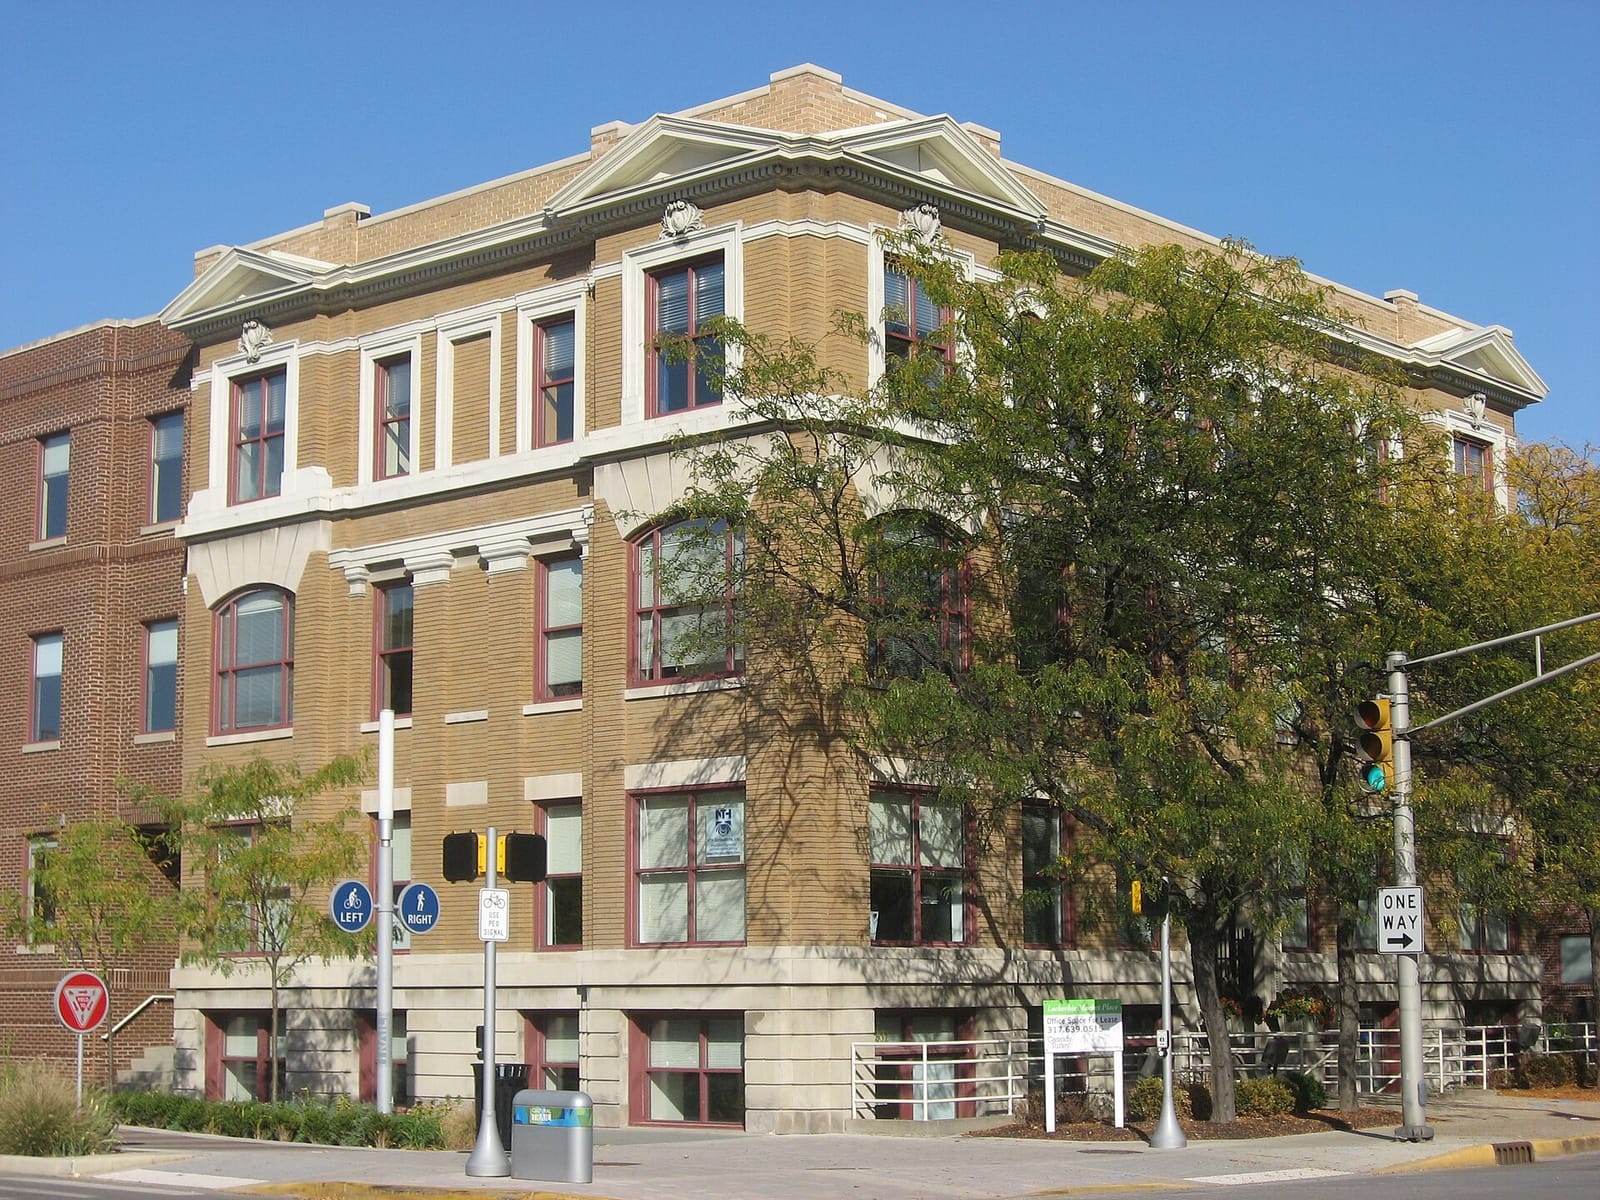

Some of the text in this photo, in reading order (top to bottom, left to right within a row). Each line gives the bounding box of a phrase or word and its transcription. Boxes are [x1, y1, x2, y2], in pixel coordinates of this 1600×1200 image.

[1384, 894, 1417, 910] ONE
[340, 911, 364, 923] LEFT
[407, 914, 433, 925] RIGHT
[1383, 915, 1418, 930] WAY
[482, 928, 504, 937] SIGNAL
[1047, 1016, 1065, 1025] Office
[1067, 1016, 1087, 1026] Space
[1100, 1016, 1119, 1024] Lease
